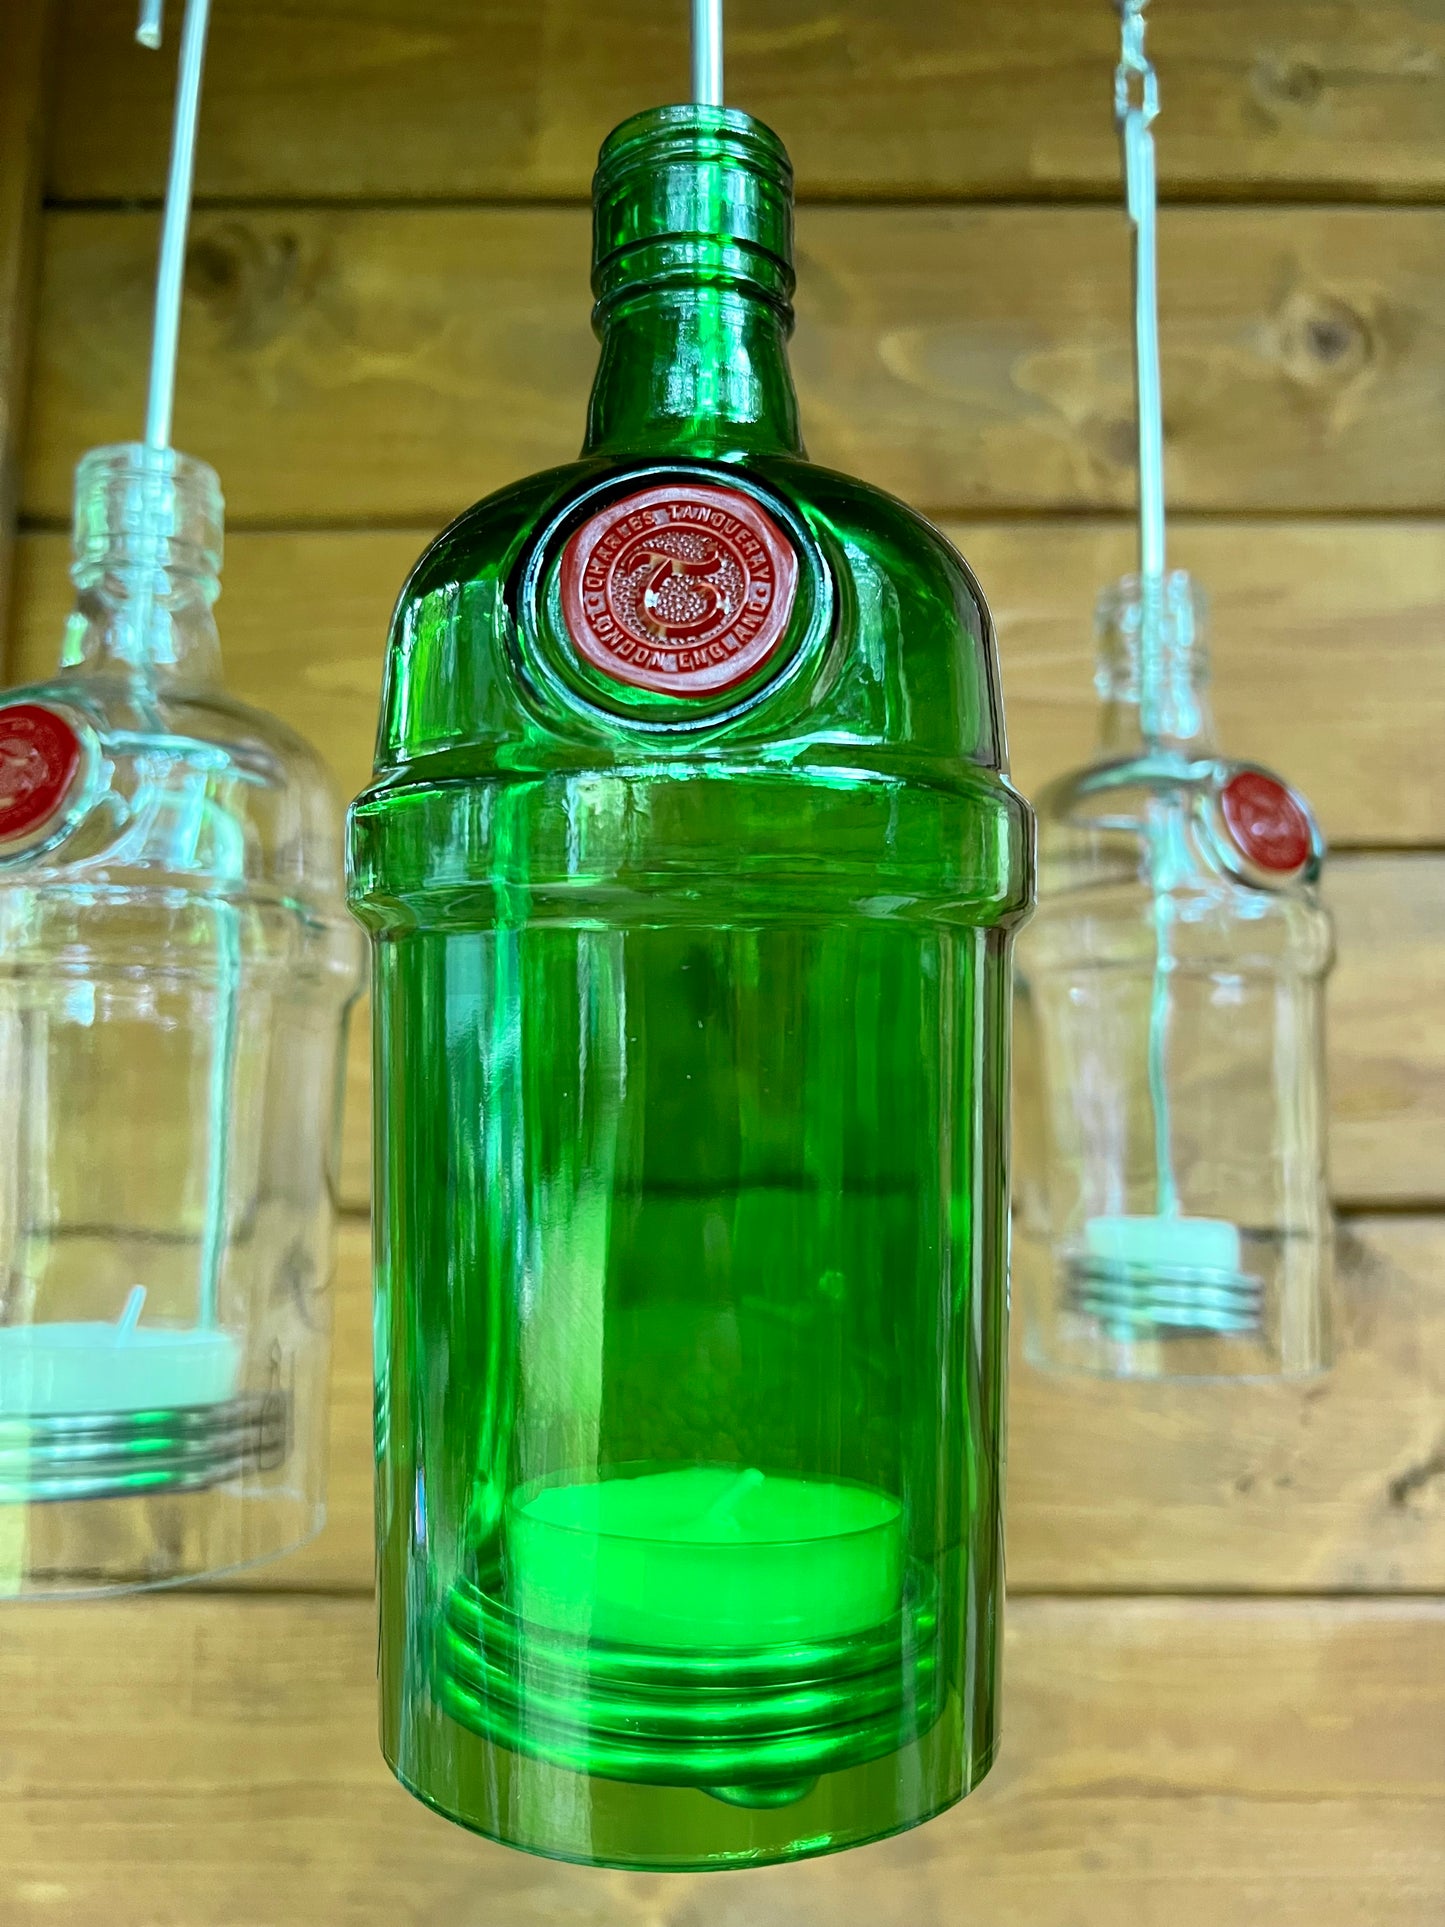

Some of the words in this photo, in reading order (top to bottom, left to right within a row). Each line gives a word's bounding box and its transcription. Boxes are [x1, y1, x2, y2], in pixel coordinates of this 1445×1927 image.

[586, 511, 656, 588] CHARLES
[667, 504, 770, 580] TANQUERAY
[589, 612, 665, 667] LONDON
[678, 601, 766, 669] ENGLAND
